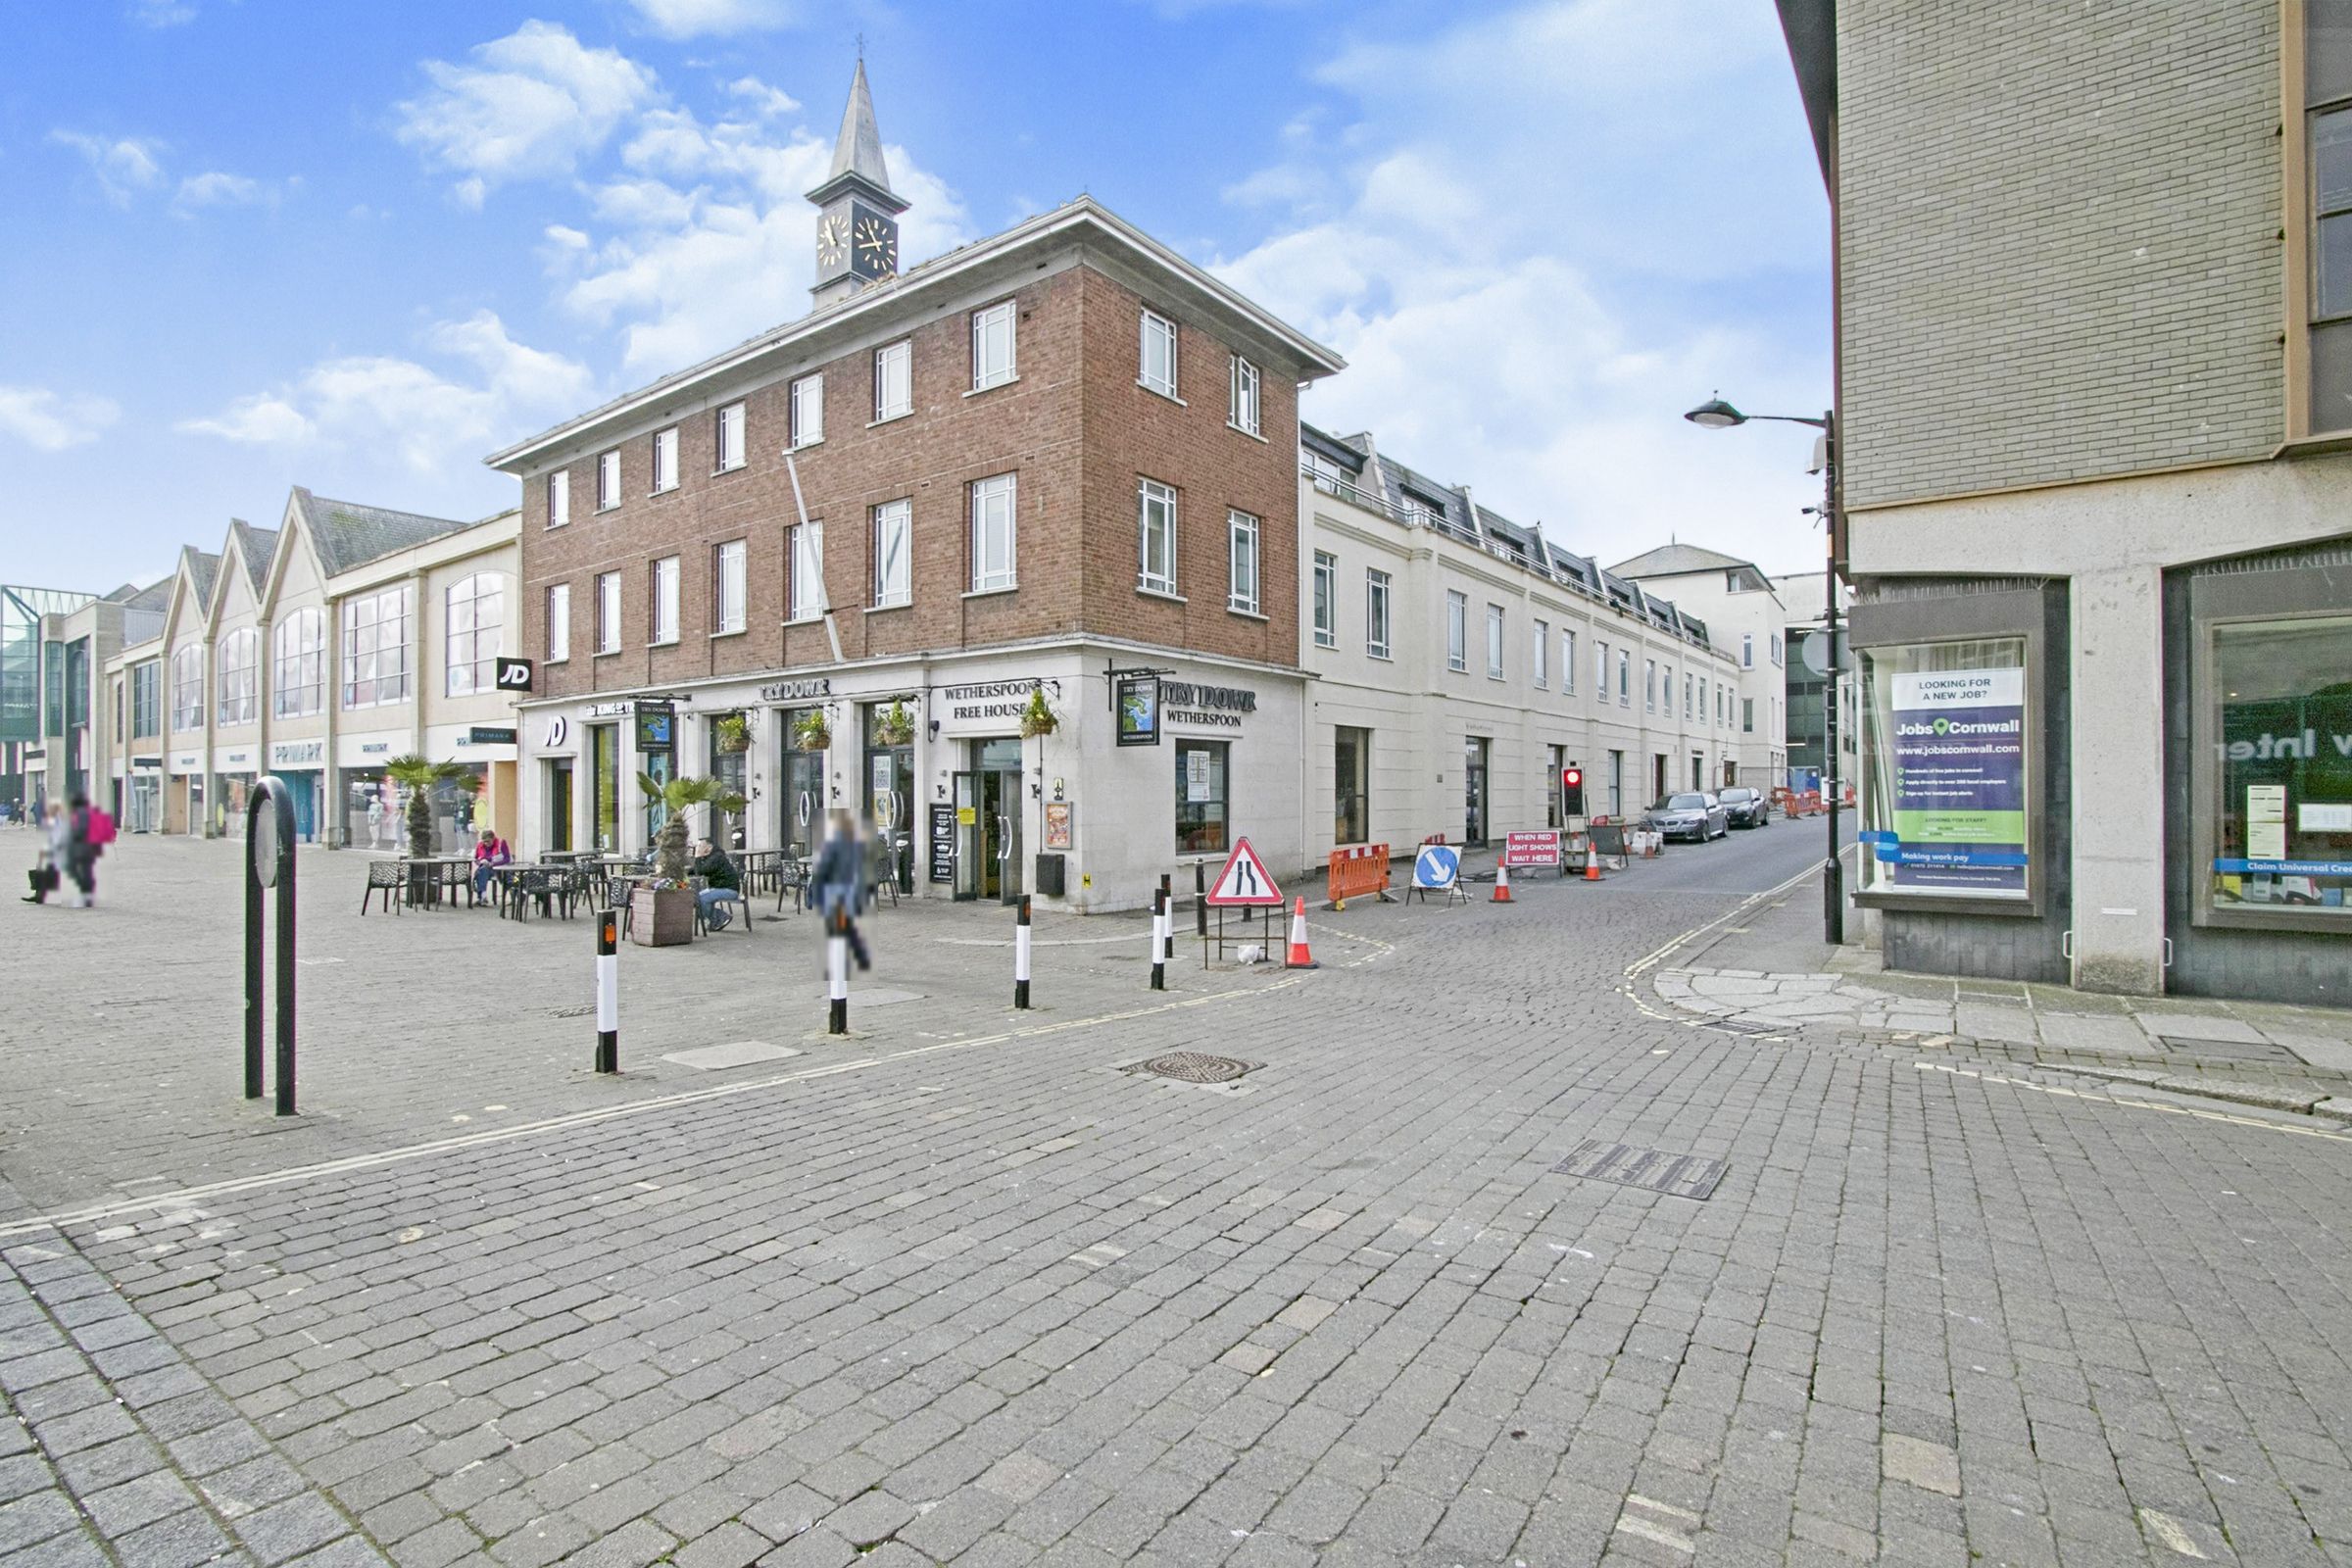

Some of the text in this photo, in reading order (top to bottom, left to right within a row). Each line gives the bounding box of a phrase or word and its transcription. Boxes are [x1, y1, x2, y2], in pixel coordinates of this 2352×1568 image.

[499, 663, 530, 684] JD
[1919, 678, 1990, 690] LOOKING FOR
[1933, 692, 1956, 701] NEW
[1960, 690, 1987, 700] JOB?
[954, 703, 1027, 719] FREE HOUSE
[1167, 710, 1242, 727] WETHERSPOON
[543, 715, 567, 747] JD
[1896, 719, 2020, 736] Jobs Cornwall
[275, 743, 322, 763] PRIMARK
[1896, 745, 2020, 757] www.jobscornwall.com
[1901, 853, 1930, 861] Making
[2278, 863, 2328, 872] Universal
